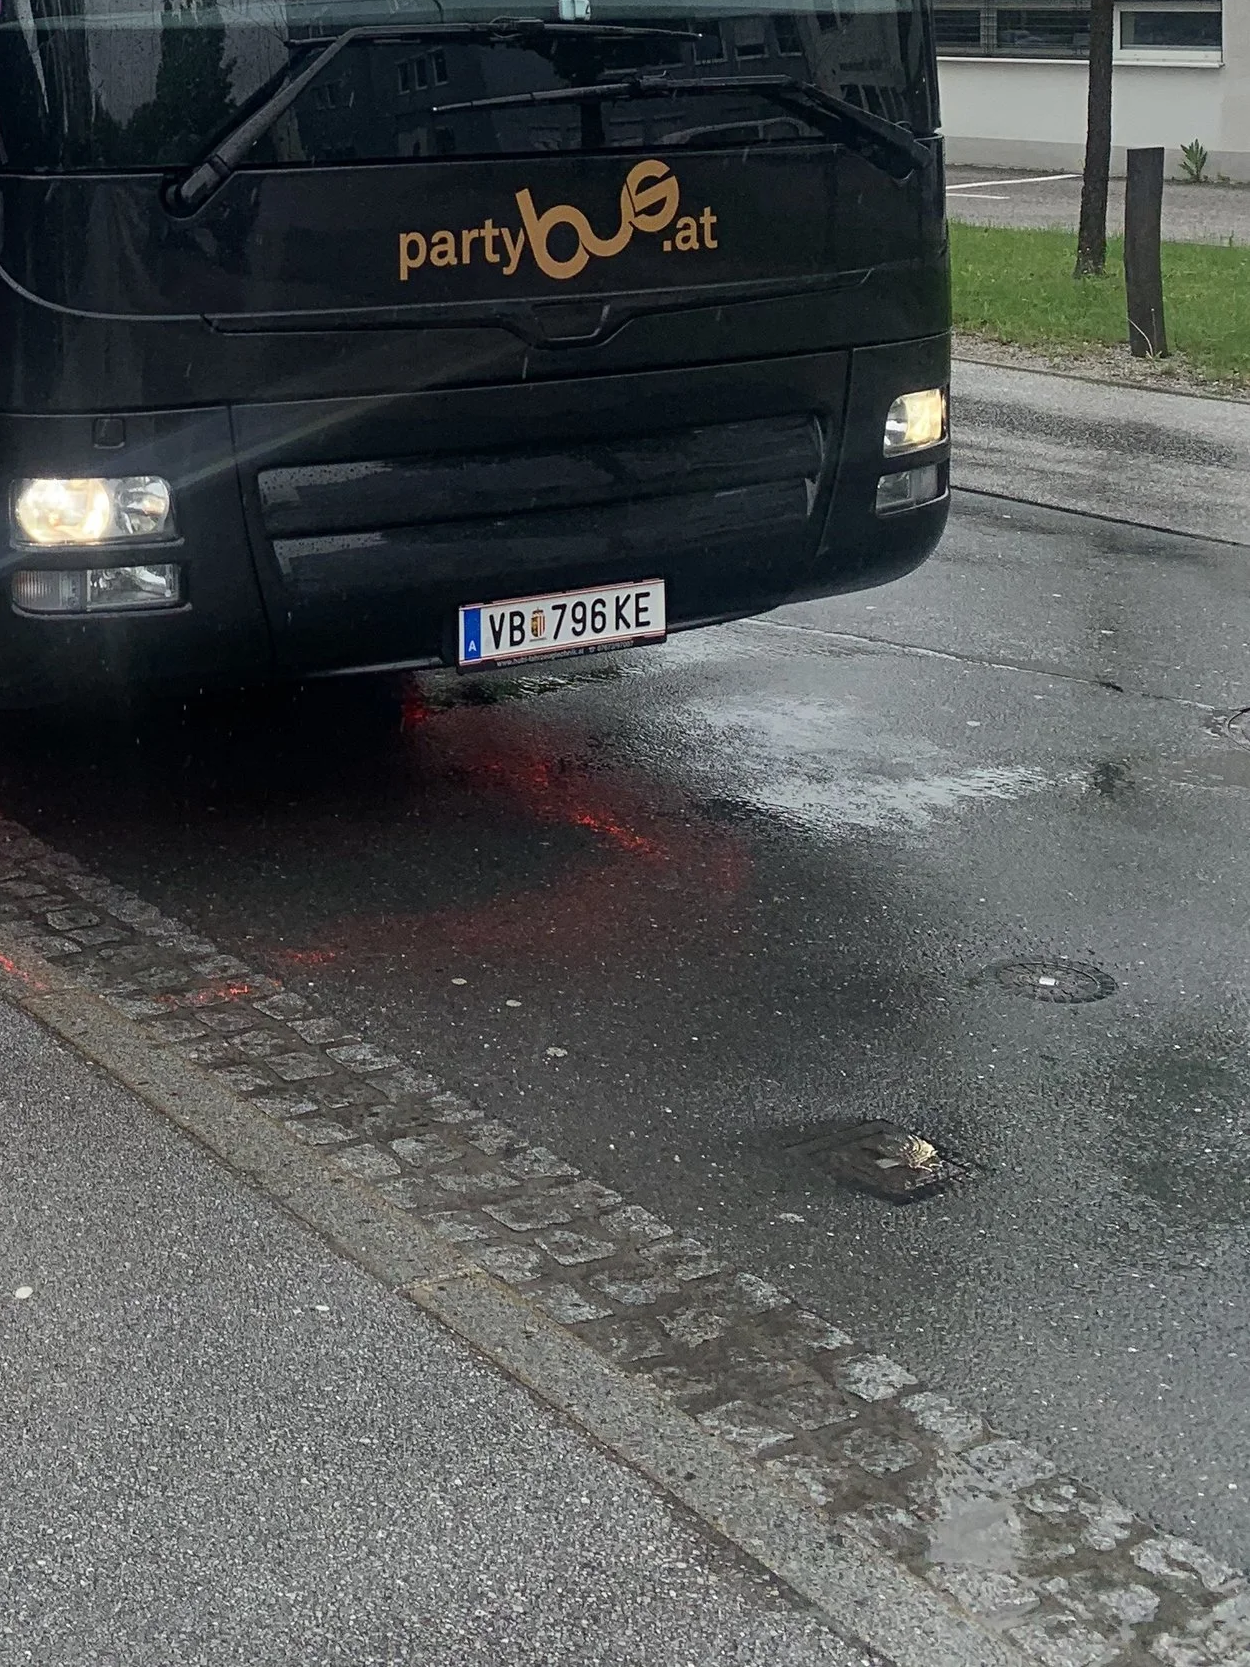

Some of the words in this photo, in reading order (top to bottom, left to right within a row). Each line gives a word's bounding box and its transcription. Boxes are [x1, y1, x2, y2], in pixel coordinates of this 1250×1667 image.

[399, 158, 718, 281] partybus.at
[467, 639, 478, 653] A
[488, 610, 526, 650] VB
[551, 598, 607, 640] 796
[615, 591, 651, 631] KE
